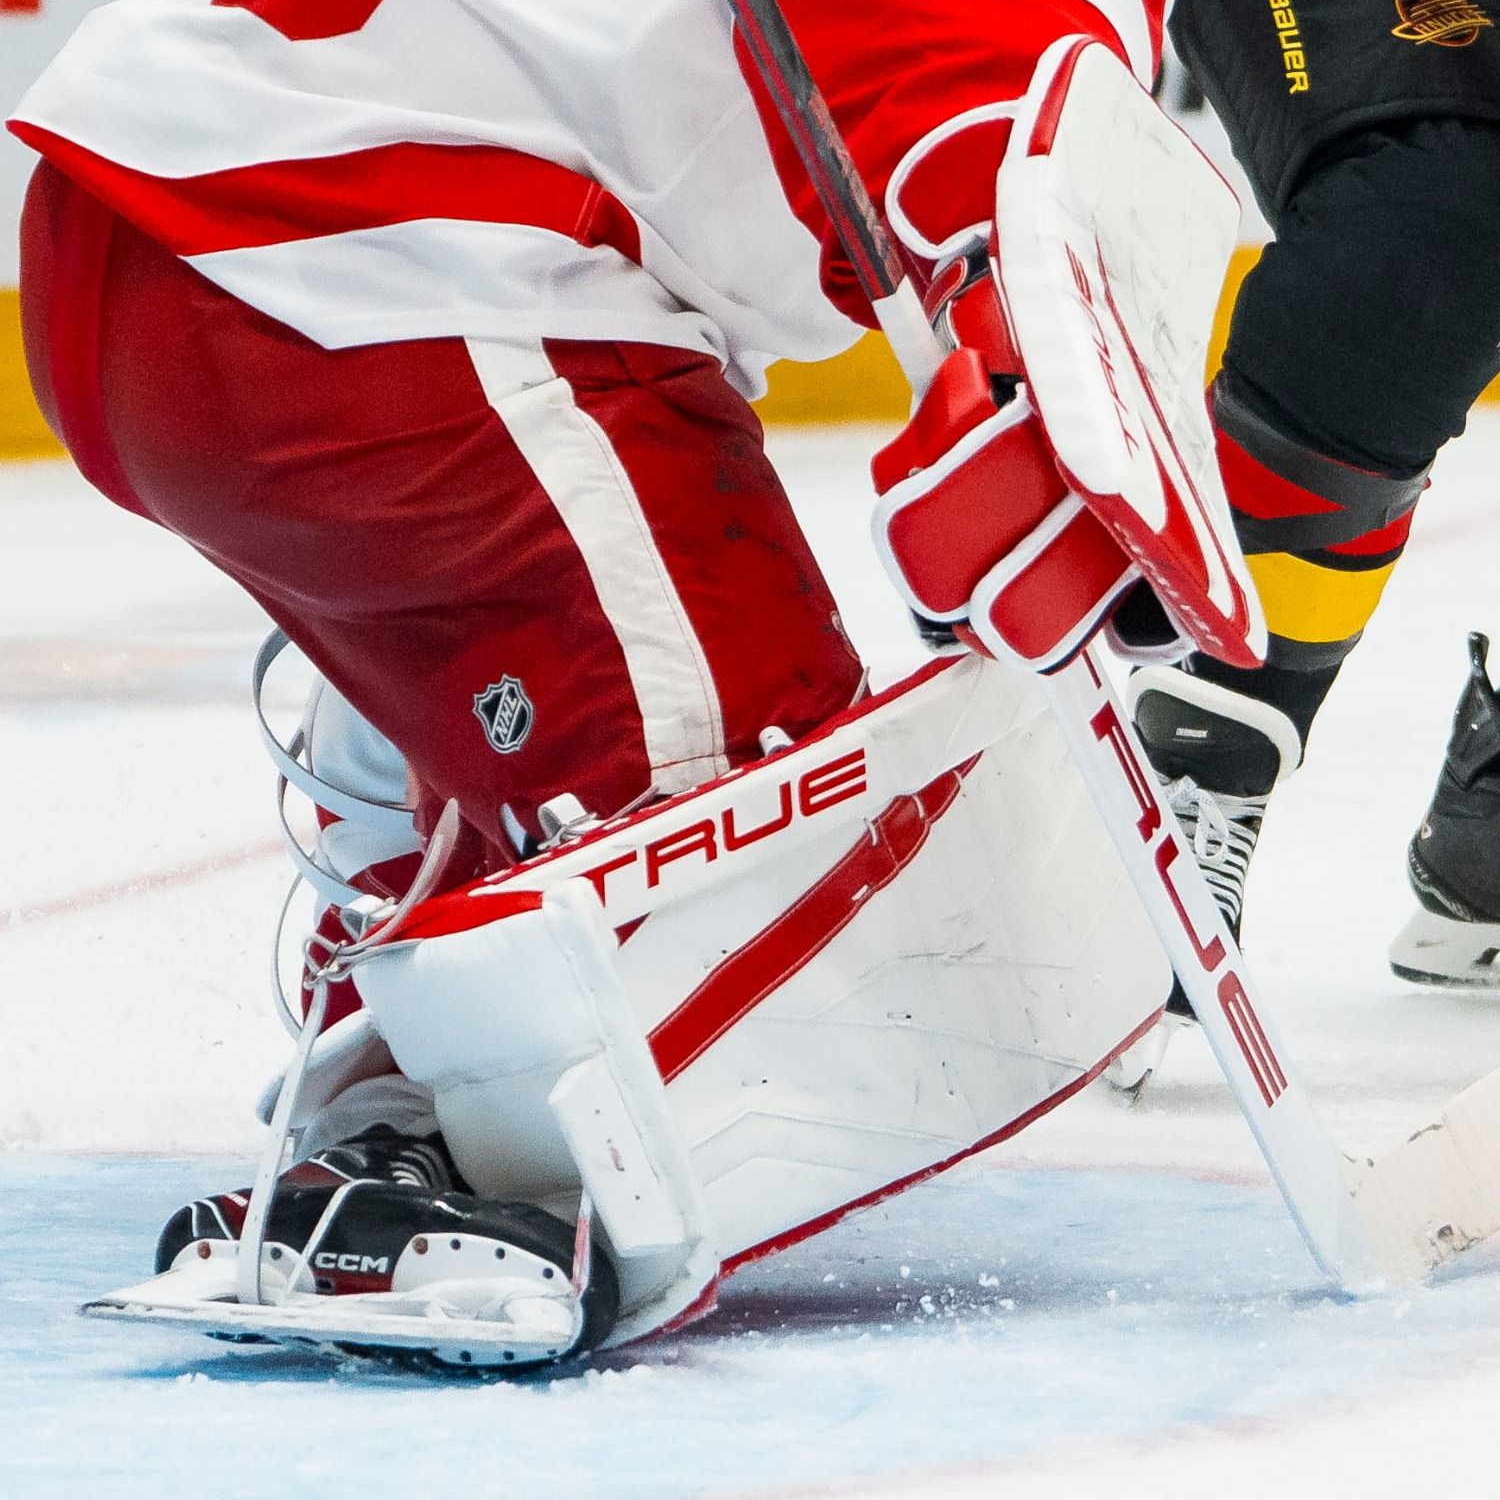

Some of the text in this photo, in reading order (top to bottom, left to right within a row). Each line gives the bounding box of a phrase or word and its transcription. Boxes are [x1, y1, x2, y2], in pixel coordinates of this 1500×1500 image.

[495, 692, 519, 744] NHL
[576, 746, 869, 910] TRUE
[314, 1251, 390, 1274] CCM
